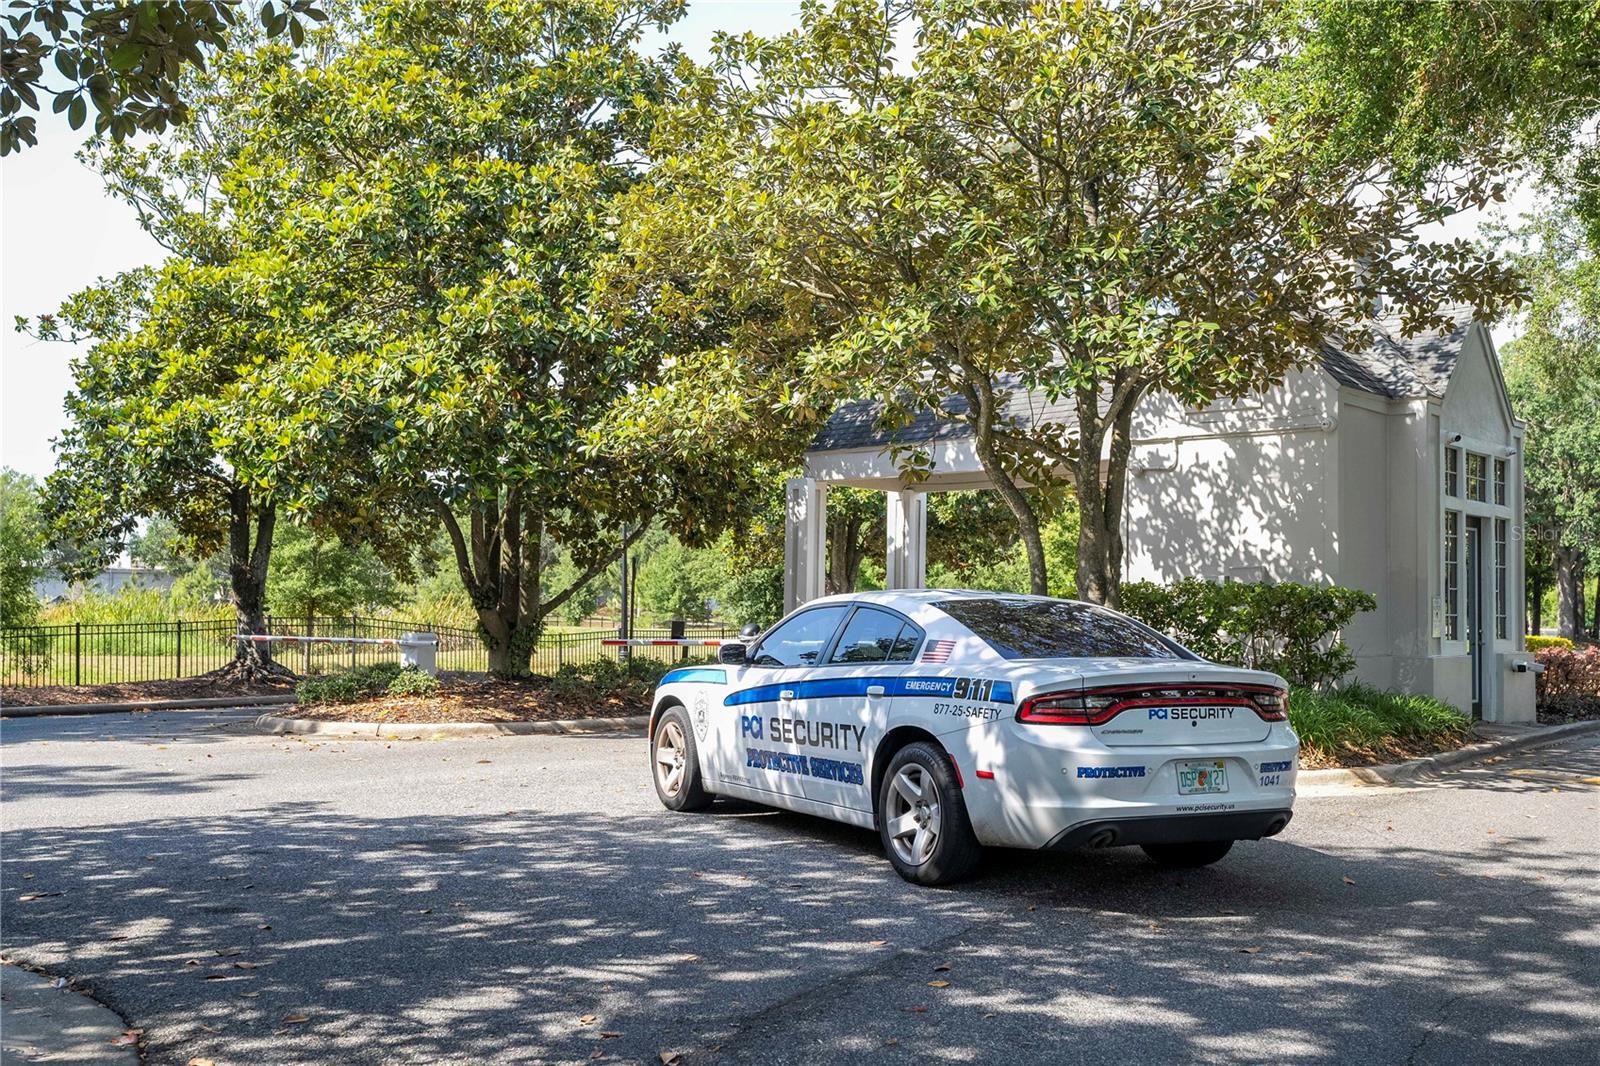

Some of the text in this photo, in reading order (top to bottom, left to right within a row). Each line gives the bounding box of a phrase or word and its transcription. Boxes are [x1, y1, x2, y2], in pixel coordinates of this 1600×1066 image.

[905, 677, 993, 702] EMERGENCY 911
[933, 703, 1002, 720] 877-25-SAFETY
[1148, 708, 1235, 719] PCI SECURITY
[742, 715, 867, 752] PCI SECURITY
[746, 747, 809, 775] PROTECTIVE
[810, 756, 865, 786] SERVICES
[1077, 766, 1146, 778] PROTECTIVE
[1260, 775, 1280, 786] 1041
[1177, 804, 1235, 812] www.pcisecurity.us
